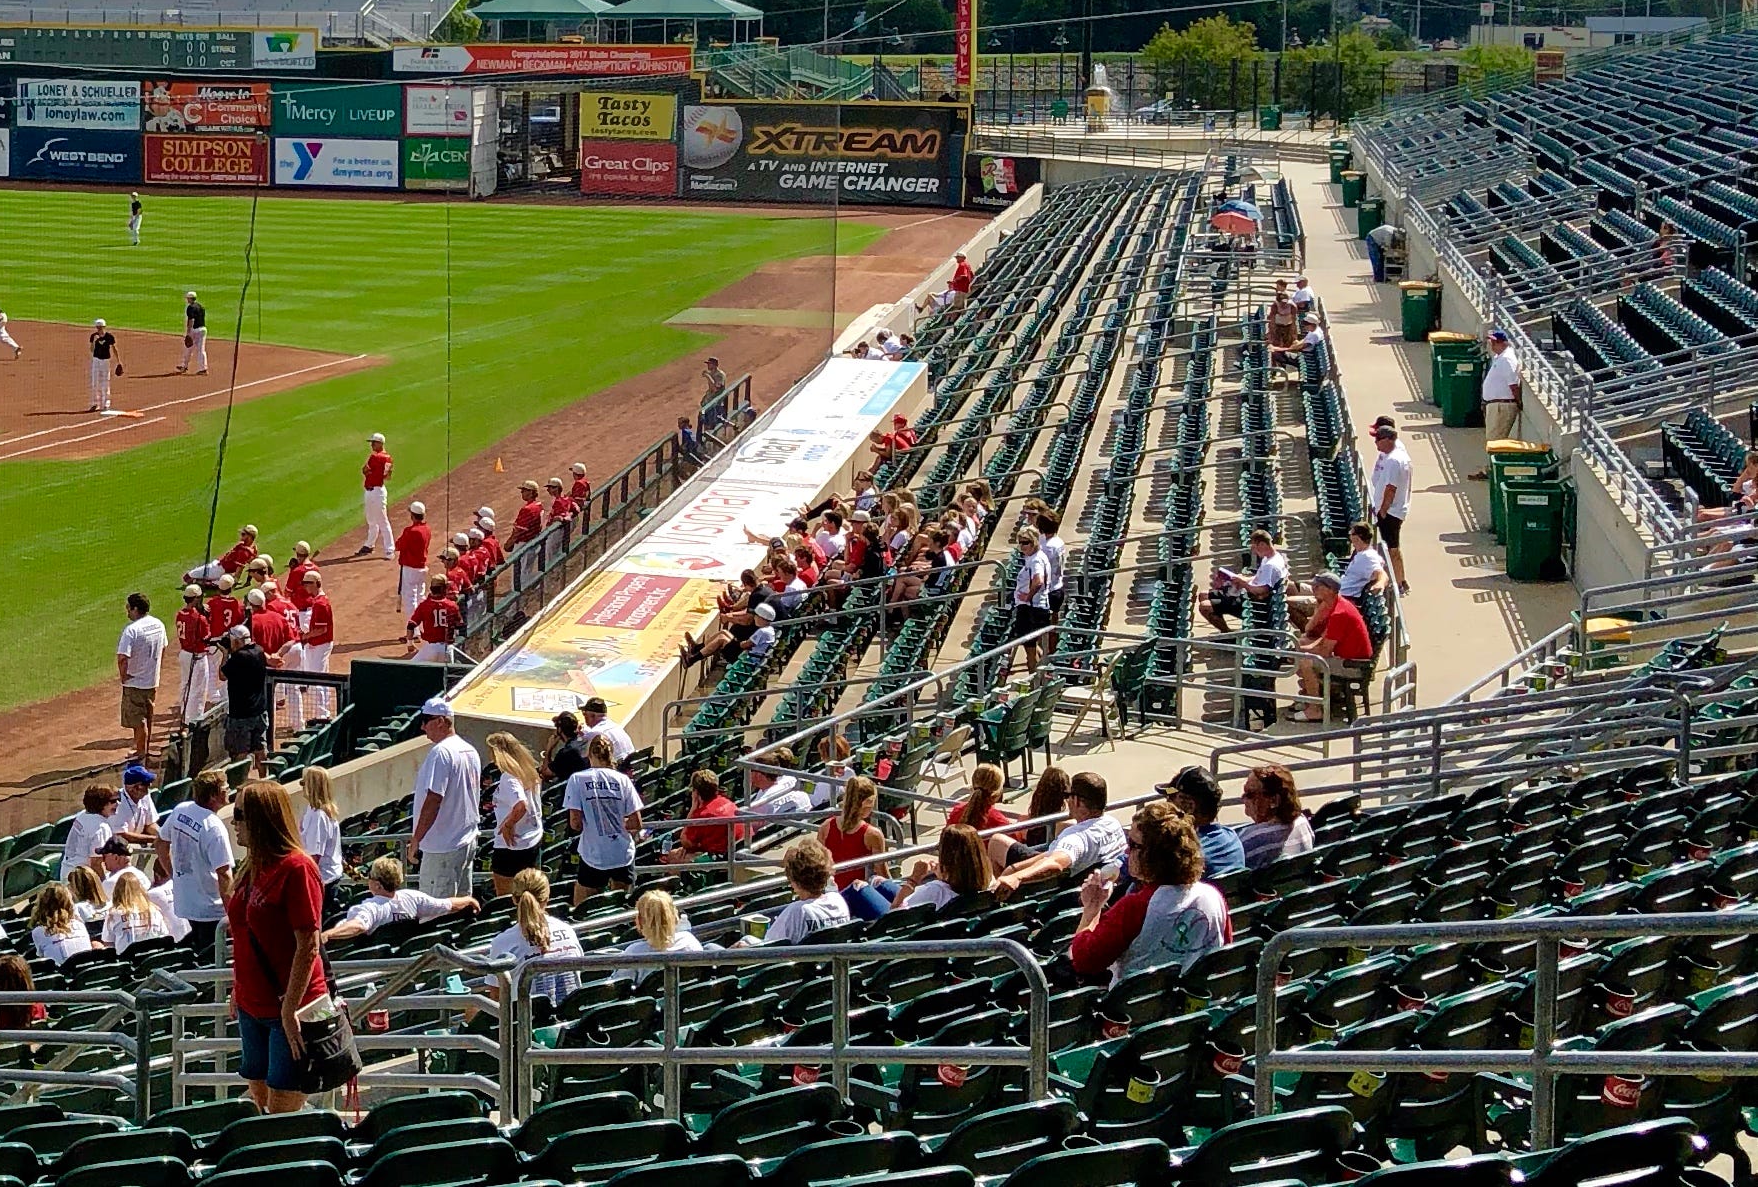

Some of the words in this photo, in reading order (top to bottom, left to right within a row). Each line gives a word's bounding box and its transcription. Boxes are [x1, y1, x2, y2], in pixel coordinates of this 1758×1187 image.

[569, 50, 587, 59] 2017
[476, 59, 517, 70] NEWMAN
[523, 59, 567, 70] BECKMAN
[572, 60, 633, 71] ASSUMPTION
[637, 60, 686, 71] JOHNSTON
[37, 85, 67, 96] LONEY
[71, 85, 78, 96] &
[81, 85, 137, 98] SCHUELLER
[598, 97, 652, 111] Tasty
[45, 107, 125, 121] loneylaw.com
[220, 114, 257, 124] Choice
[291, 104, 336, 125] Mercy
[350, 109, 396, 121] LIVEUP
[598, 112, 651, 127] Tacos
[752, 125, 938, 154] XTREAM
[50, 150, 87, 162] WEST
[88, 152, 125, 162] BEND
[162, 140, 252, 156] SIMPSON
[161, 157, 253, 173] COLLEGE
[356, 157, 379, 166] better
[585, 157, 630, 171] Great
[632, 157, 671, 173] Clips
[748, 163, 756, 171] A
[759, 161, 779, 171] TV
[784, 163, 806, 172] AND
[809, 161, 888, 173] INTERNET
[333, 166, 393, 181] dmymca.org
[779, 174, 839, 190] GAME
[843, 175, 939, 193] CHANGER
[736, 437, 807, 464] Smart
[642, 483, 779, 545] Visionary
[585, 589, 629, 625] Professional
[223, 611, 232, 627] 3
[433, 611, 449, 628] 16
[176, 621, 186, 639] 21
